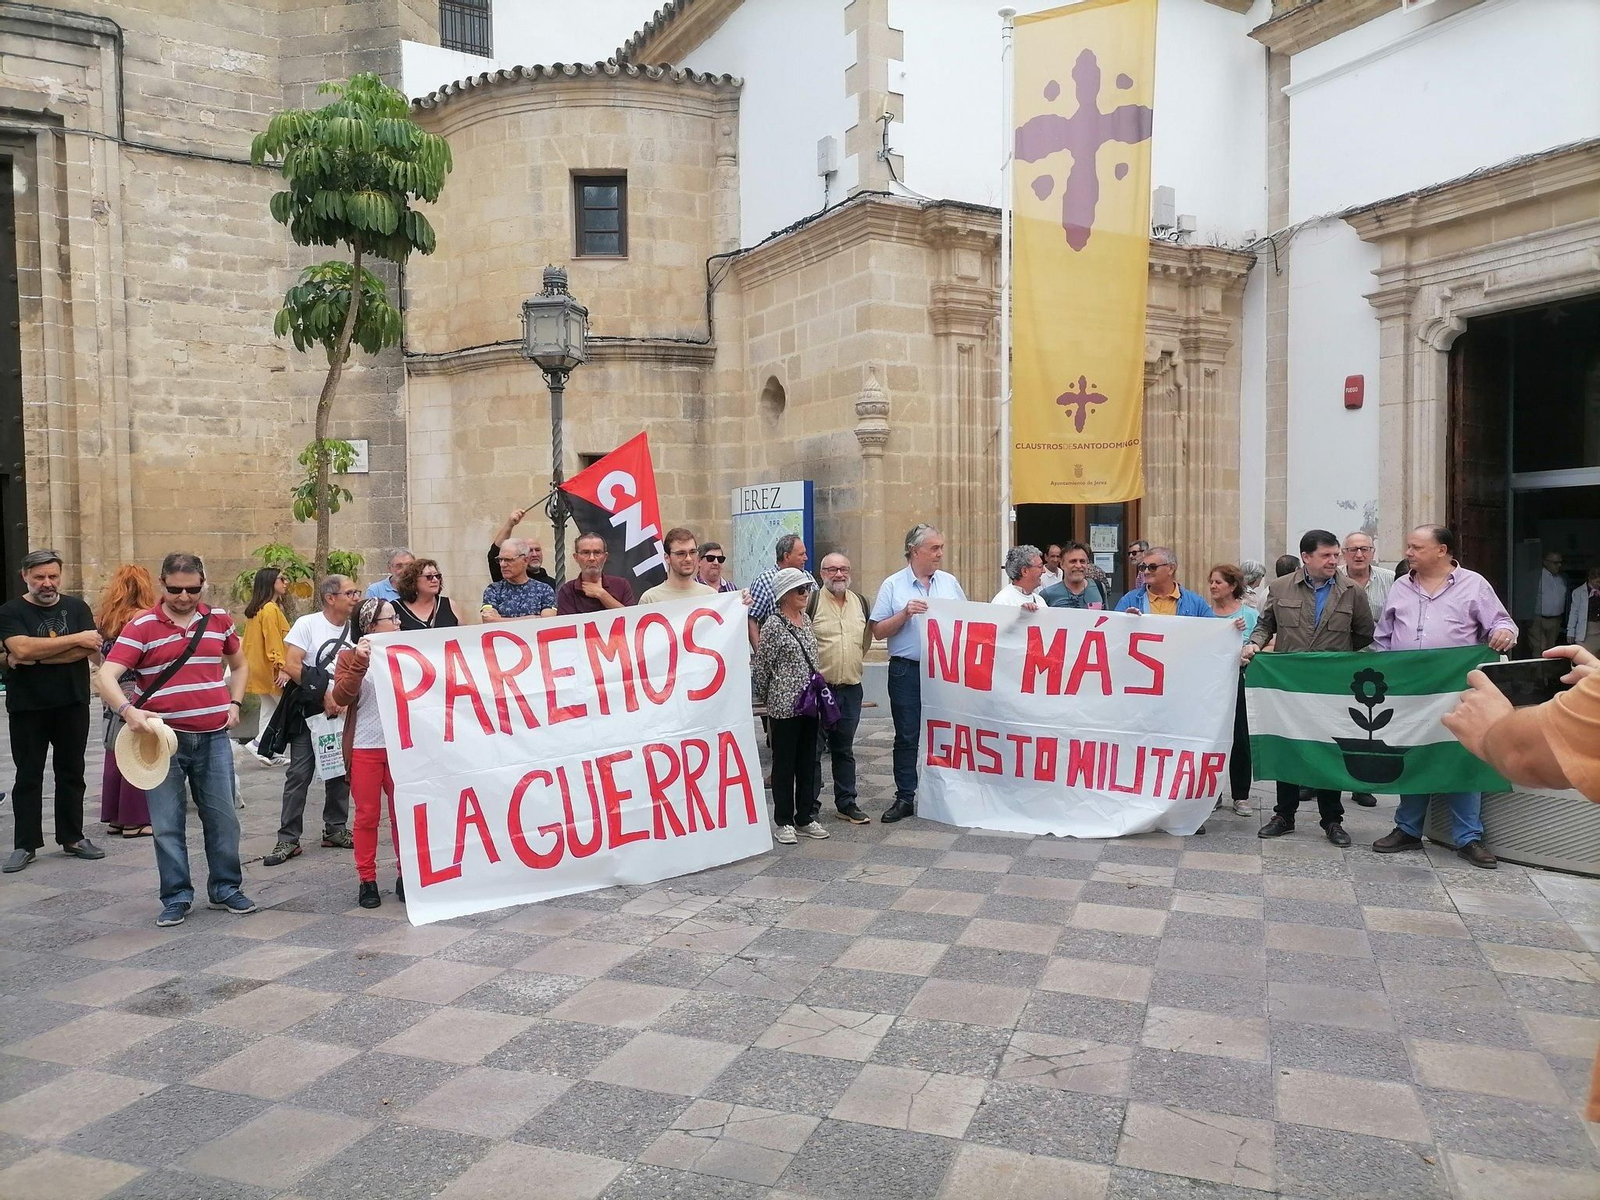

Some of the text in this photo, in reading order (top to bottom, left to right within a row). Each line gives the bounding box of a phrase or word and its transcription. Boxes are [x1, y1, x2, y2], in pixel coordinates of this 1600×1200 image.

[596, 469, 669, 578] CNT
[740, 486, 781, 516] JEREZ
[386, 608, 727, 750] PAREMOS
[927, 616, 1164, 696] NO MÁS
[927, 719, 1226, 800] GASTO MILITAR
[413, 731, 758, 888] LA GUERRA
